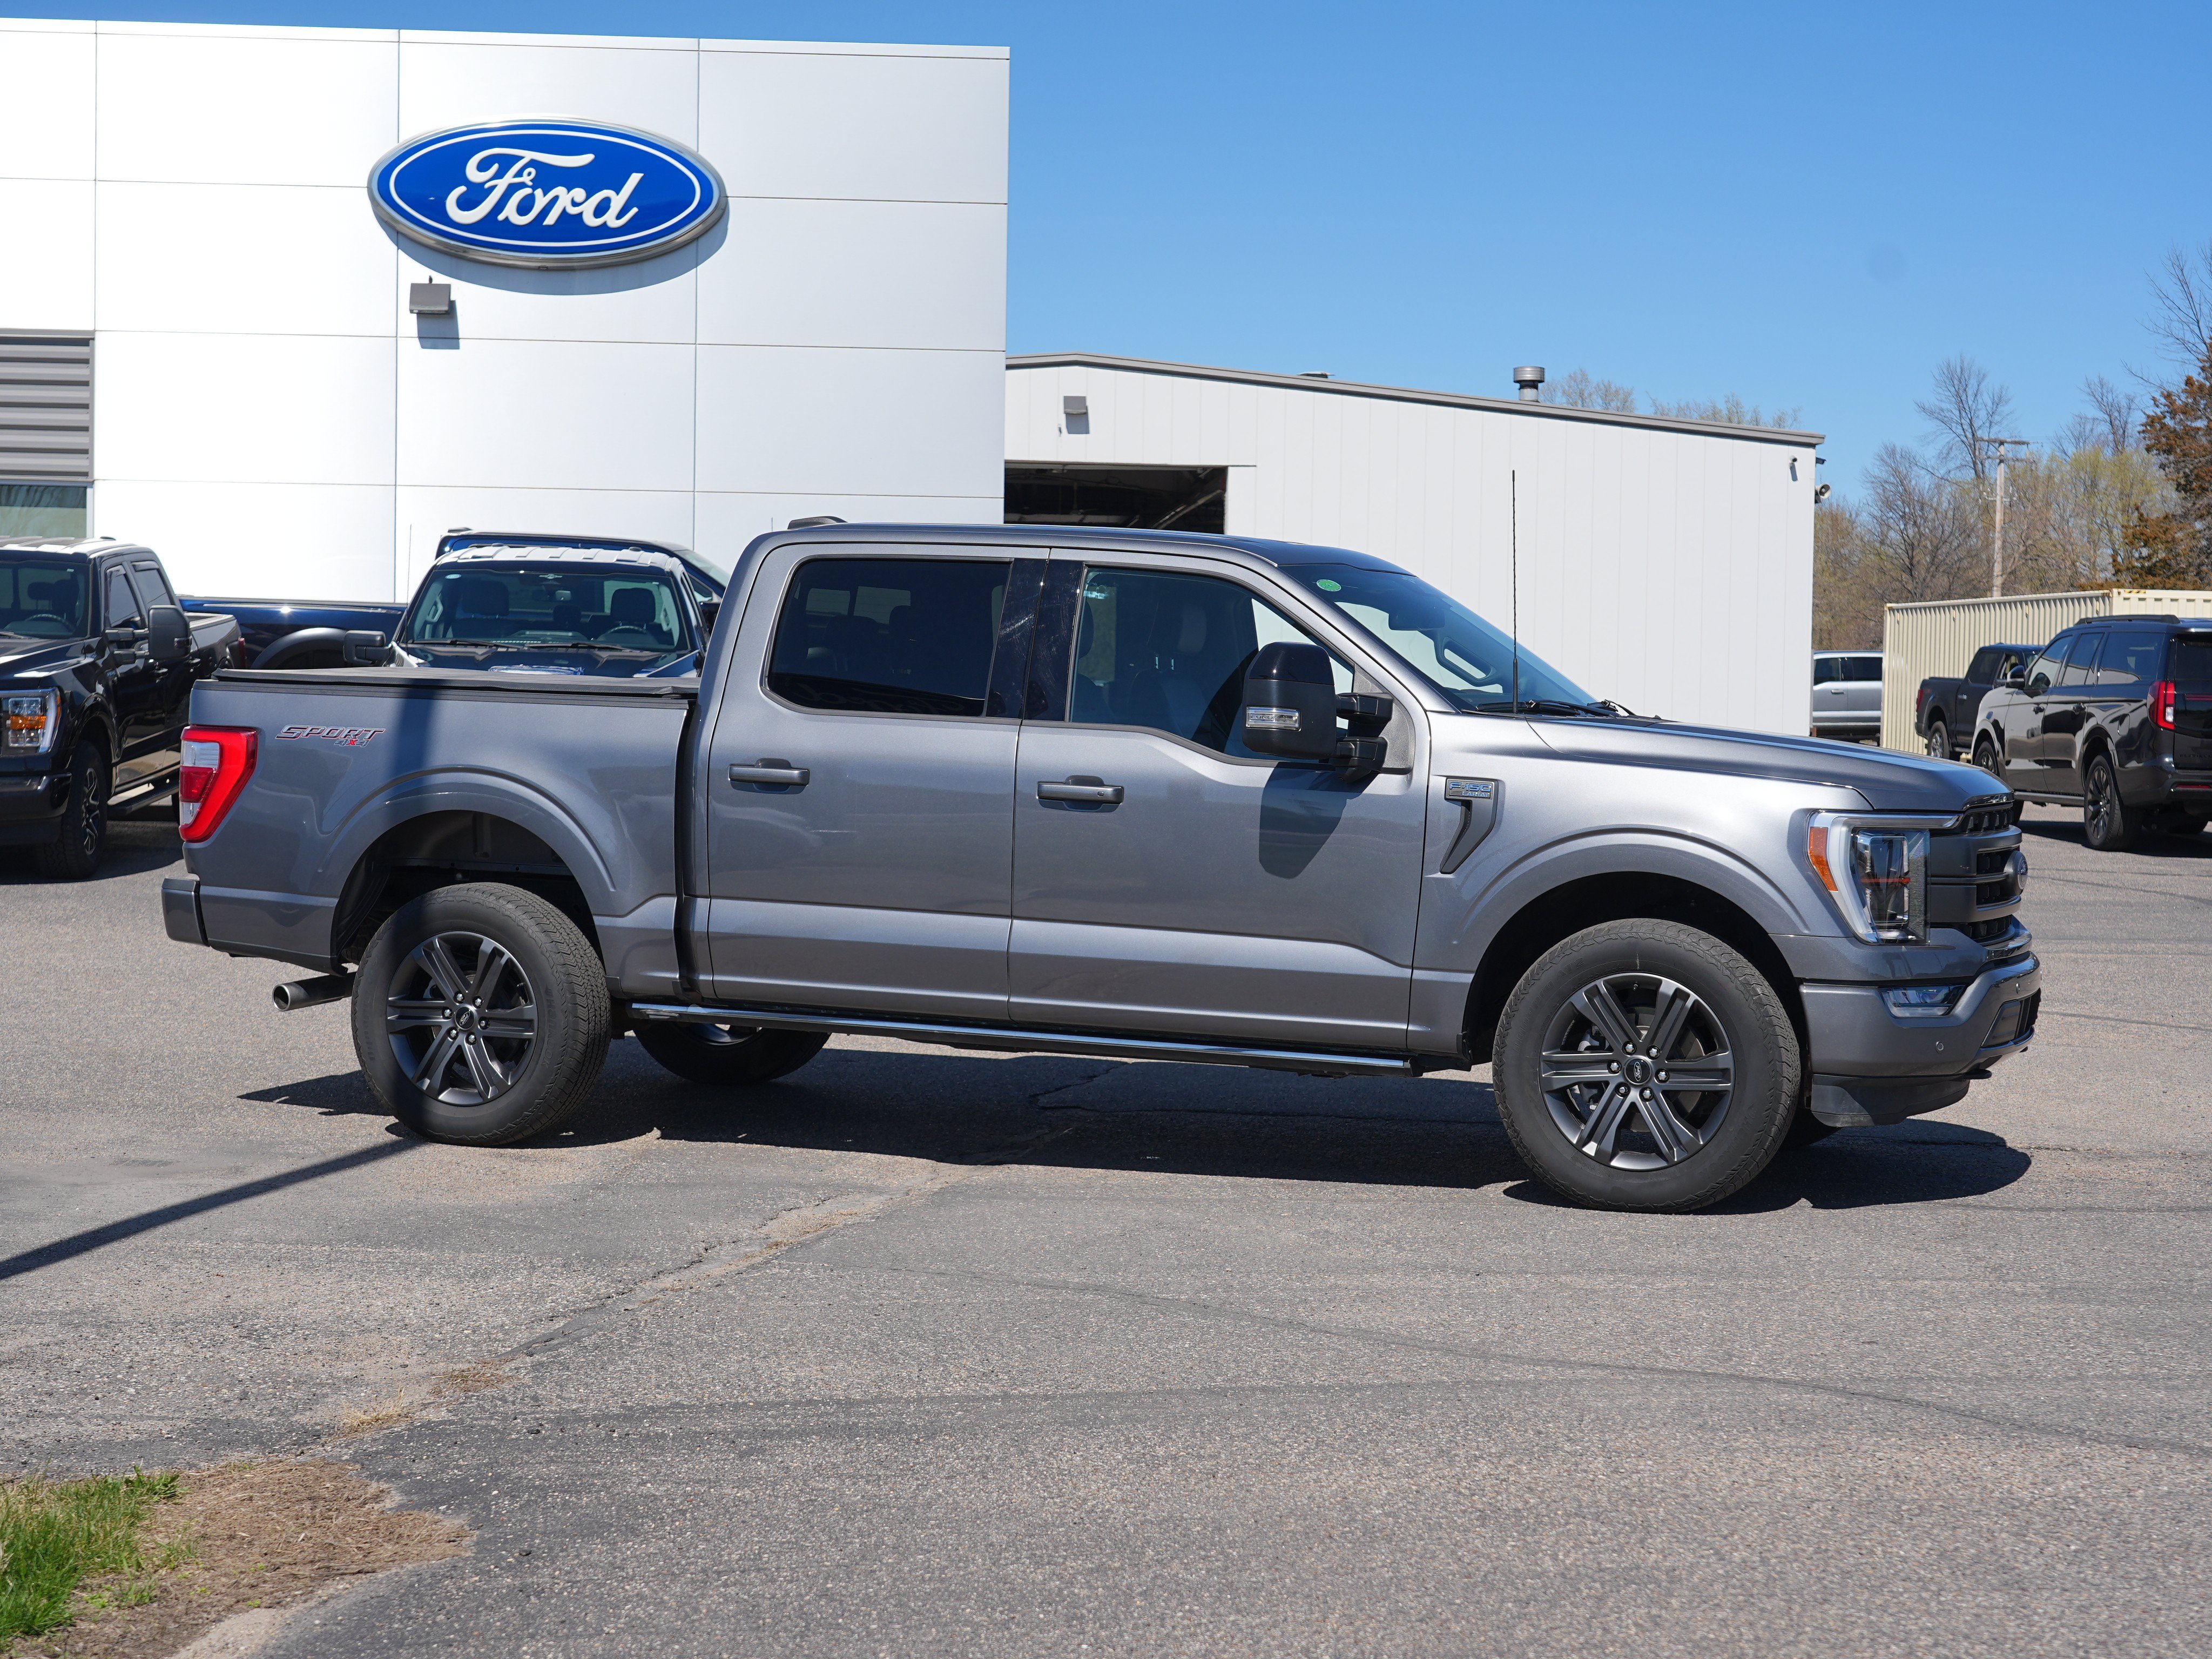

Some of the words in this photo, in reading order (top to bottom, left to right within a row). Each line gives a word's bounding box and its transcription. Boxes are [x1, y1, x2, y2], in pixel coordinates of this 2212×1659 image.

[446, 148, 644, 228] Ford
[275, 724, 386, 740] SPORT
[1449, 782, 1492, 792] F-150
